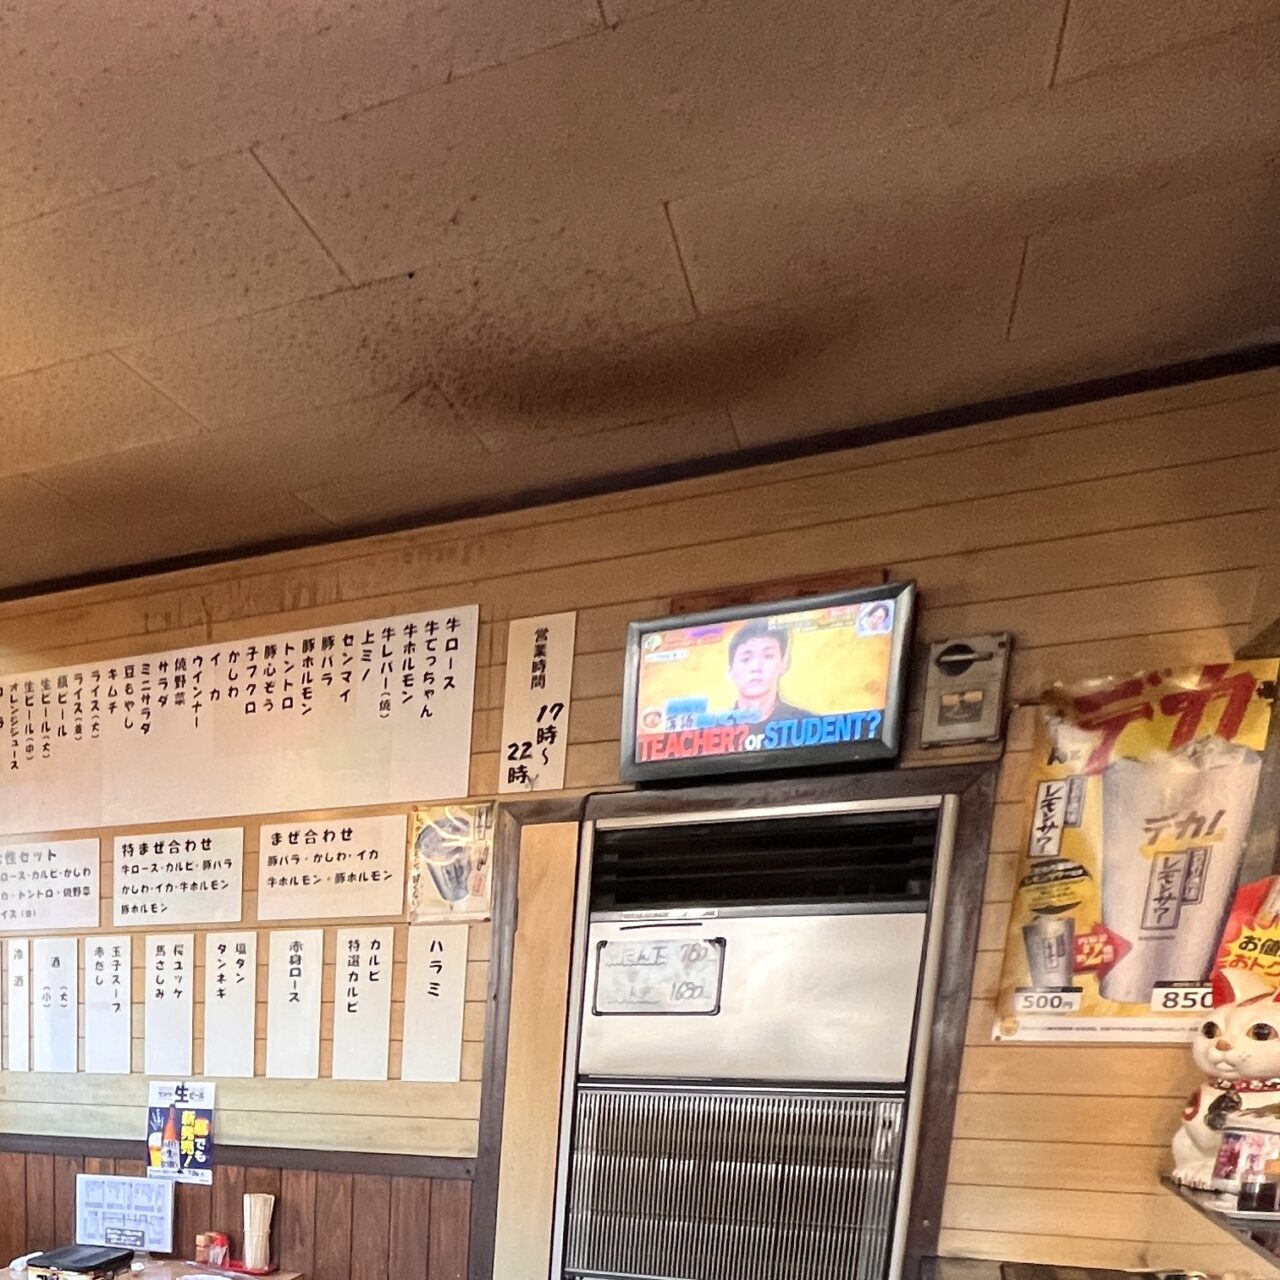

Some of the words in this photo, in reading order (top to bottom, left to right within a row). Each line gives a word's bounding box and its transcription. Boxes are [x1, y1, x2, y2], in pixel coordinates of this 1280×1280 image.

[228, 650, 240, 698] かしわ
[245, 646, 259, 714] 子フクロ
[282, 643, 295, 710] トントロ
[321, 635, 335, 686] 豚バラ
[340, 633, 354, 703] センマイ
[361, 629, 375, 682] 上ミノ
[402, 623, 417, 704] 牛ホルモン
[420, 620, 439, 718] 牛てっちゃん
[443, 617, 461, 689] 牛ロース
[531, 627, 549, 690] 営業時間
[108, 668, 118, 714] キムチ
[124, 664, 135, 729] 豆もやし
[140, 663, 151, 734] ミニサラダ
[158, 659, 169, 708] サラダ
[192, 655, 203, 728] ウインナー
[507, 741, 533, 784] 22時
[639, 724, 750, 760] TEACHER?
[744, 733, 765, 751] or
[763, 711, 882, 750] STUDENT?
[121, 837, 212, 857] 特まぜ合わせ
[270, 827, 354, 847] まぜ合わせ
[155, 944, 165, 999] 馬さしみ
[216, 943, 227, 999] タンネギ
[235, 942, 247, 984] 塩タン
[289, 940, 303, 1003] 赤身ロース
[347, 939, 360, 1014] 特選カルビ
[369, 939, 381, 982] カルビ
[427, 940, 444, 997] ハラミ
[175, 1084, 188, 1103] 生
